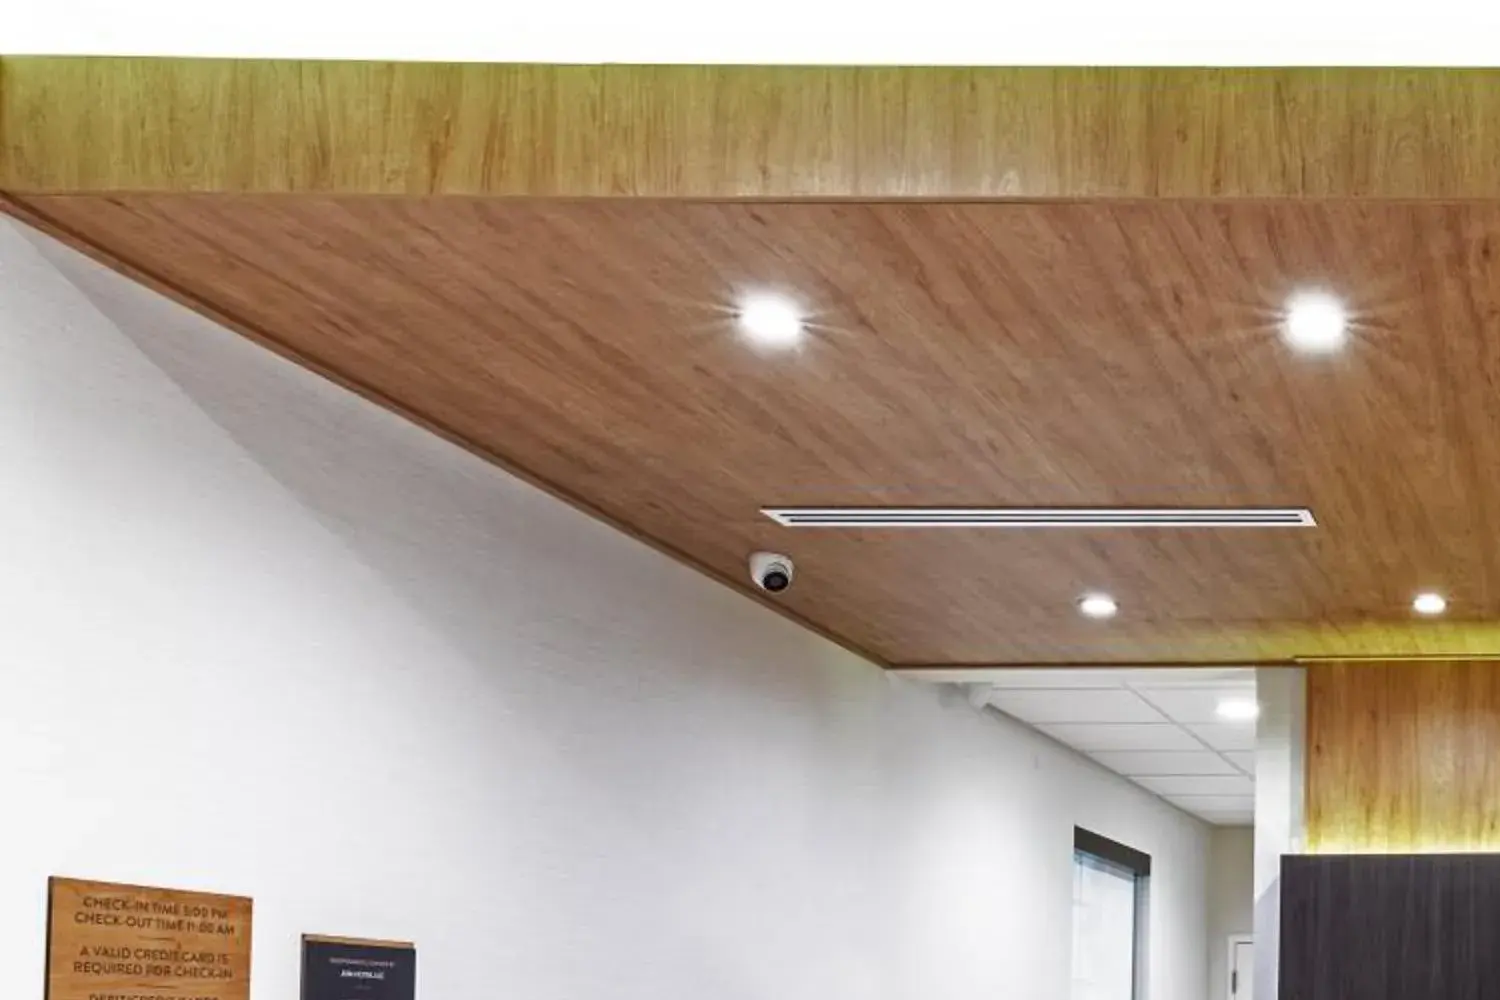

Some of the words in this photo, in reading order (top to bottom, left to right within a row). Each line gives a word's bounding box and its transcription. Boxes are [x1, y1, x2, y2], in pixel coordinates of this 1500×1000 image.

[83, 896, 149, 913] CHECK-IN
[152, 901, 179, 915] TIME
[74, 911, 150, 929] CHECK-OUT
[155, 917, 185, 932] TIME
[216, 923, 235, 935] AM
[79, 946, 89, 957] A
[95, 947, 131, 960] VALID
[133, 948, 180, 962] CREDIT
[181, 951, 214, 964] CARD
[217, 953, 229, 965] IS
[73, 961, 143, 975] REQUIRED
[145, 965, 170, 977] FOR
[175, 965, 232, 979] CHECK-IN
